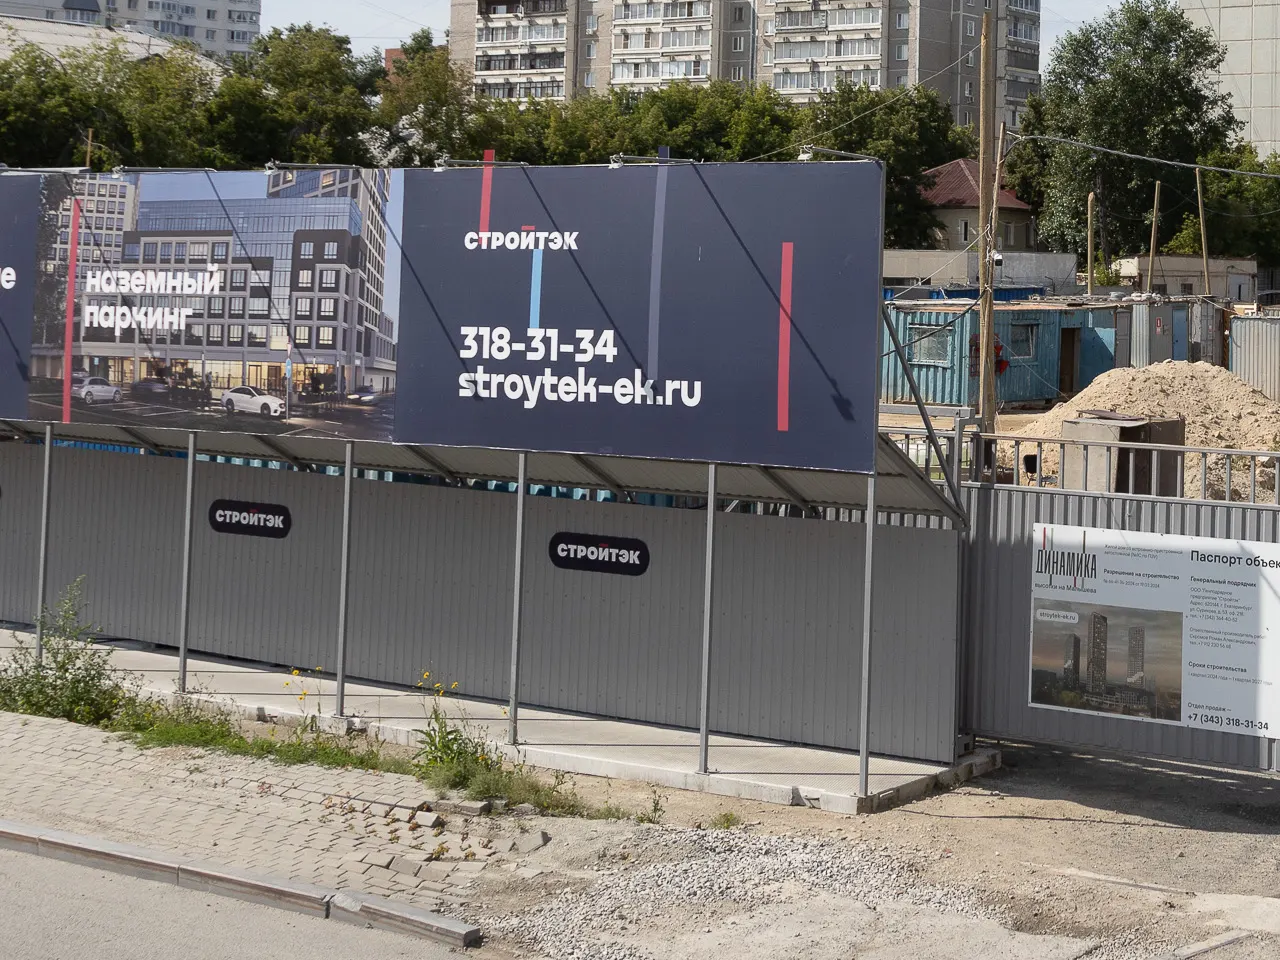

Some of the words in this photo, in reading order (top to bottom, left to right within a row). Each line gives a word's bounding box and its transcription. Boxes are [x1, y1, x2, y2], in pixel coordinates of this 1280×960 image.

[464, 225, 579, 250] СТРОЙТЭК
[86, 263, 221, 295] наземный
[84, 305, 193, 337] паркинг
[459, 326, 617, 363] 318-31-34
[458, 365, 702, 409] stroytek-ek.ru
[215, 508, 284, 529] СТРОЙТЭК
[557, 543, 641, 565] СТРОЙТЭК
[1035, 548, 1097, 578] ДИНАМИКА
[1190, 550, 1243, 567] Паспорт
[1103, 568, 1134, 576] Разрешение
[1141, 572, 1179, 580] строительство
[1190, 575, 1226, 585] Генеральный
[1226, 579, 1256, 588] подрядчик
[1066, 585, 1096, 593] Малышева
[1206, 663, 1247, 673] строительства
[1187, 702, 1204, 710] Отдел
[1205, 704, 1226, 713] продаж
[1187, 712, 1197, 721] +7
[1199, 713, 1223, 727] (343)
[1225, 716, 1268, 730] 318-31-34
